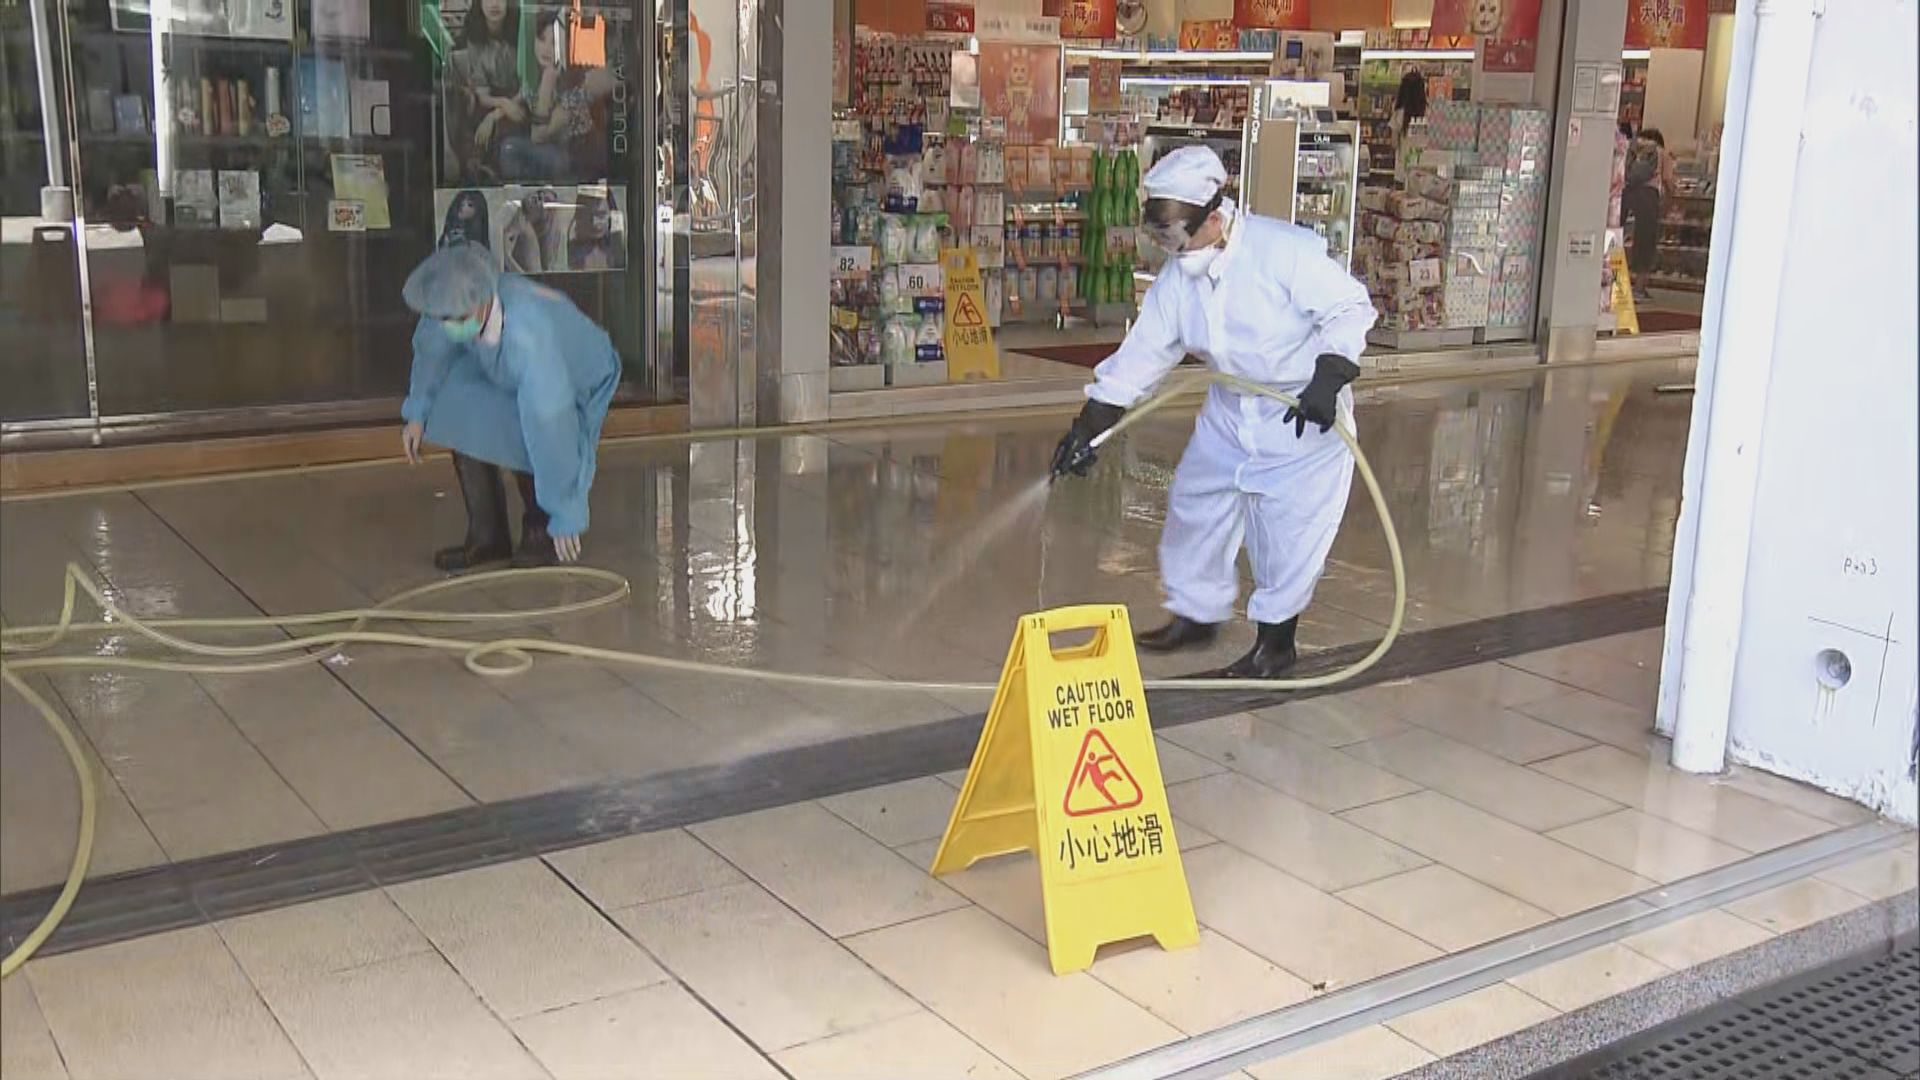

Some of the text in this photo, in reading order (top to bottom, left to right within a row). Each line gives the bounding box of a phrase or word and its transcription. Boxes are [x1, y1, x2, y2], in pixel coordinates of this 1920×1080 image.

[839, 257, 855, 271] 82
[908, 276, 924, 289] 60
[1056, 678, 1121, 705] CAUTION
[1048, 700, 1135, 729] WET FLOOR
[1060, 813, 1163, 870] 小心地滑
